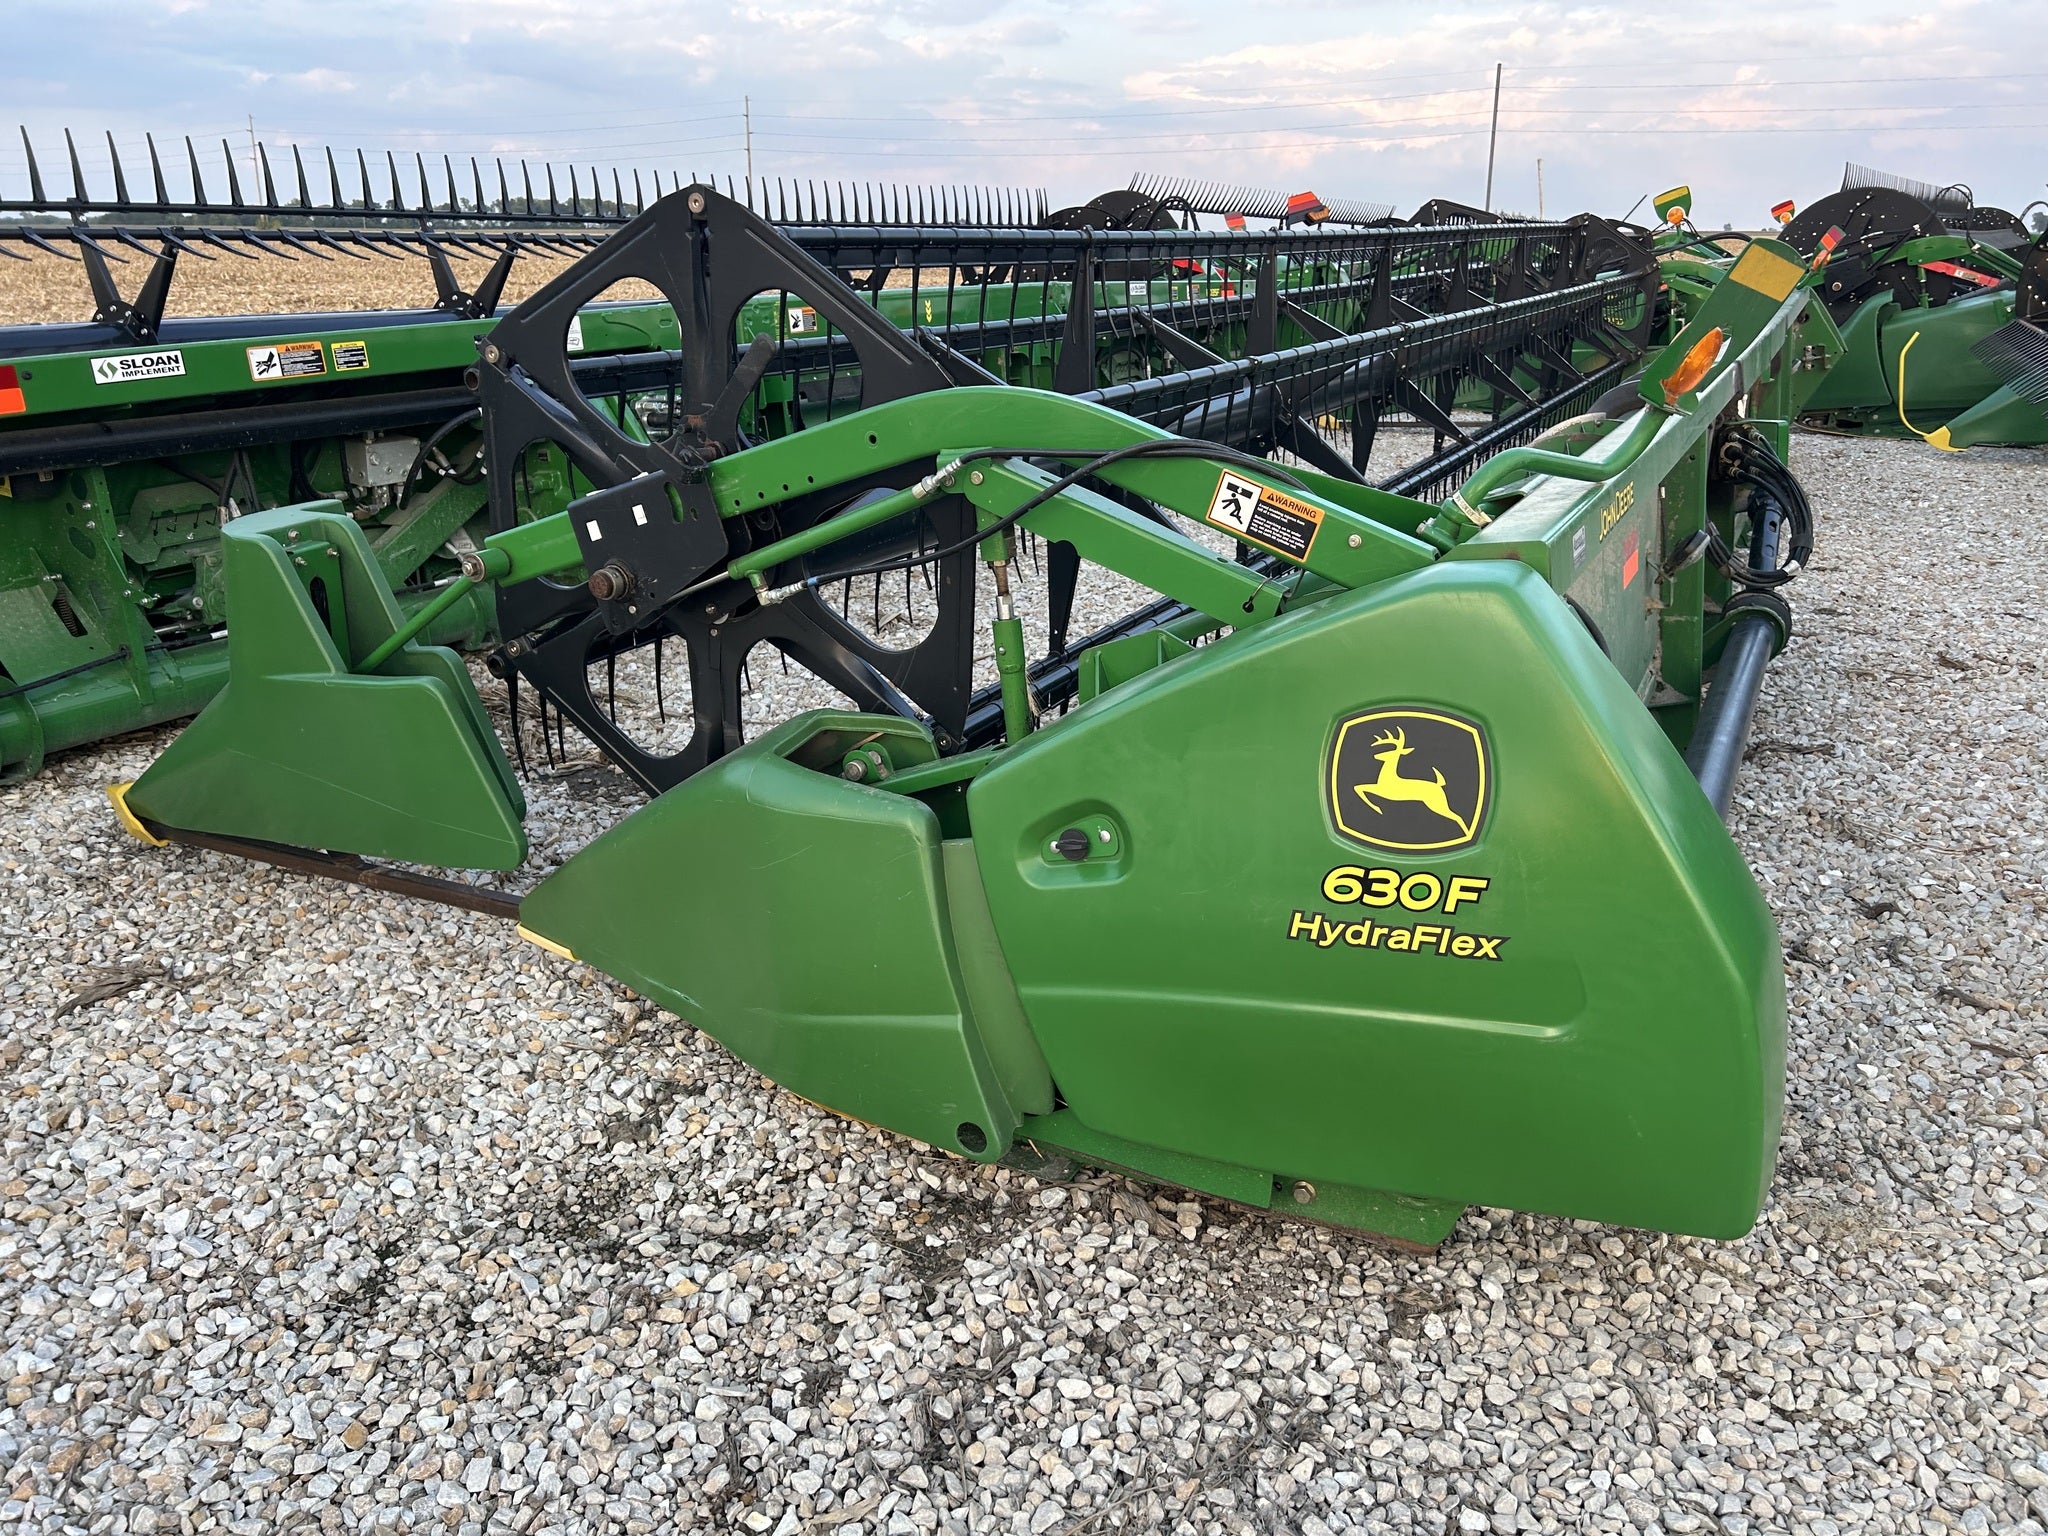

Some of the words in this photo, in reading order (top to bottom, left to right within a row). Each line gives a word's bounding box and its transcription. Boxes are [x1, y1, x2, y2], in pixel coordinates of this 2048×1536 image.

[290, 343, 316, 351] WARNING
[119, 354, 180, 370] SLOAN
[121, 365, 181, 378] IMPLEMENT
[1275, 494, 1317, 519] WARNING
[1322, 865, 1490, 914] 630F
[1288, 911, 1504, 960] HydraFlex
